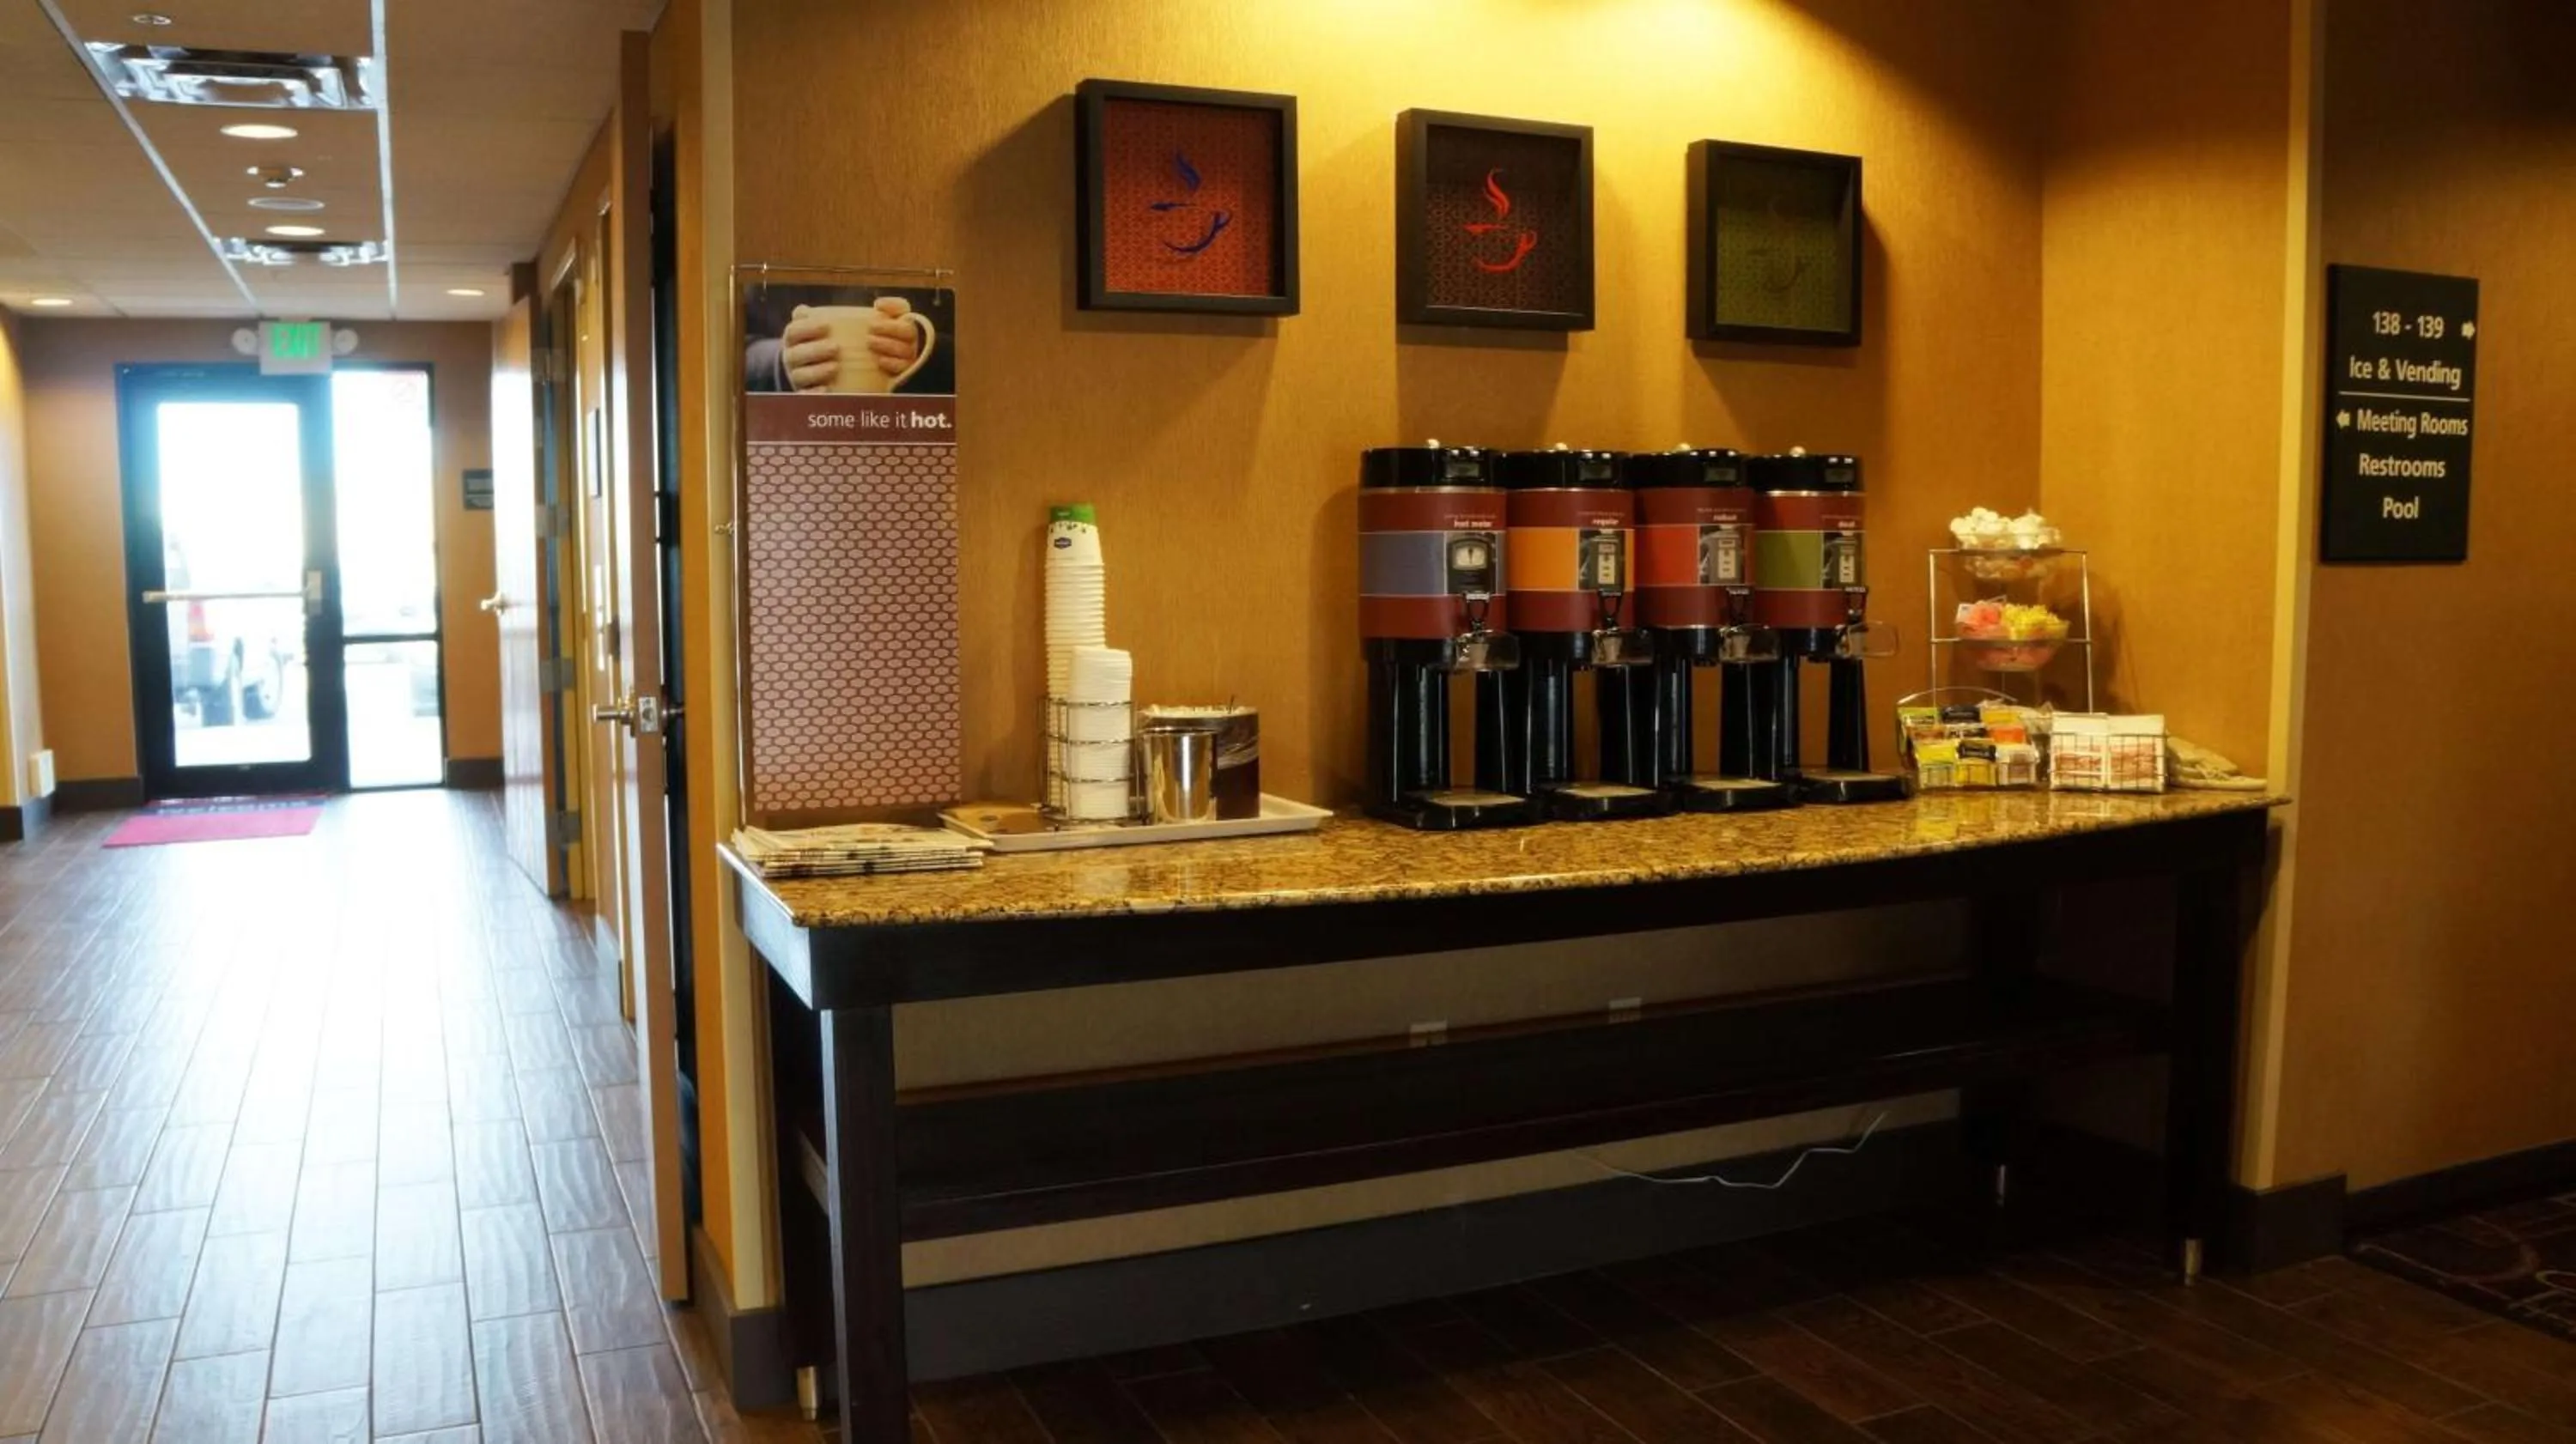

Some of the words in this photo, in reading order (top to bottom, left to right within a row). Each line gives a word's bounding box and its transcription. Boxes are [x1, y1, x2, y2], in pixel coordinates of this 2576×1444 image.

[2372, 311, 2401, 335] 138
[2417, 315, 2445, 338] 139
[272, 323, 320, 358] EXIT
[2349, 355, 2372, 379] Ice
[2378, 357, 2391, 380] &
[2396, 358, 2462, 390] Vending
[807, 414, 856, 428] some
[861, 411, 890, 428] like
[896, 411, 907, 428] it
[911, 410, 952, 428] hot.
[2357, 409, 2417, 439] Meeting
[2421, 412, 2469, 435] Rooms
[2359, 452, 2445, 478] Restrooms
[2383, 497, 2420, 519] Pool
